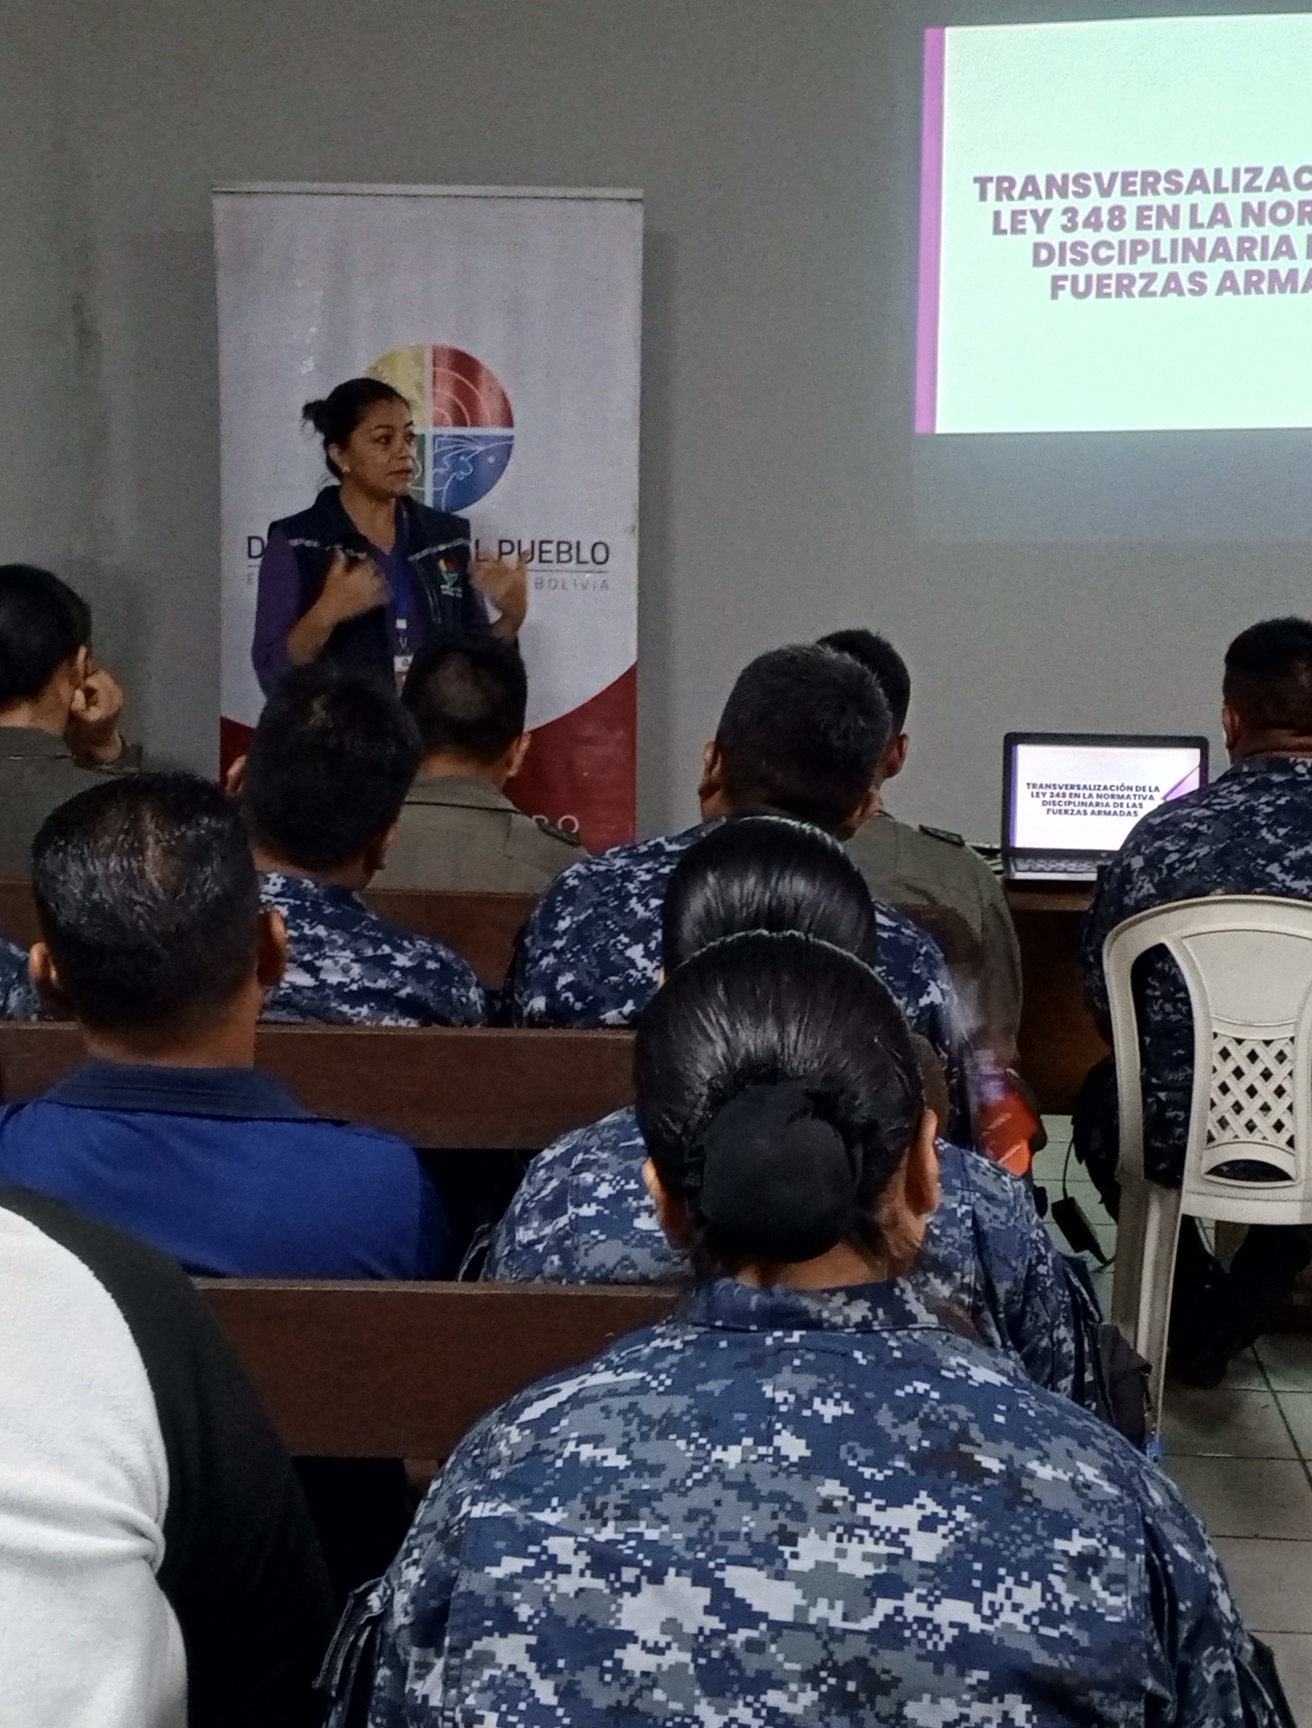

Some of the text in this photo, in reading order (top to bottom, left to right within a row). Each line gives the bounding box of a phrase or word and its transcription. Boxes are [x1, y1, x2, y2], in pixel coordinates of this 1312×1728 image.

[992, 208, 1053, 236] LEY
[1060, 204, 1127, 234] 348
[1135, 203, 1181, 231] EN
[1189, 202, 1233, 230] LA
[1032, 233, 1298, 268] DISCIPLINARIA
[1050, 270, 1208, 300] FUERZAS
[498, 539, 610, 565] PUEBLO
[534, 576, 610, 591] BOLIVIA
[1026, 782, 1133, 793] TRANSVERSALIZACIÓN
[1149, 785, 1160, 793] LA
[1031, 791, 1047, 799] LEY
[1082, 792, 1094, 800] LA
[1096, 793, 1155, 801] NORMATIVA
[1042, 800, 1110, 808] DISCIPLINARIA
[1112, 801, 1124, 809] DE
[1046, 808, 1138, 817] FUERZAS ARMADAS
